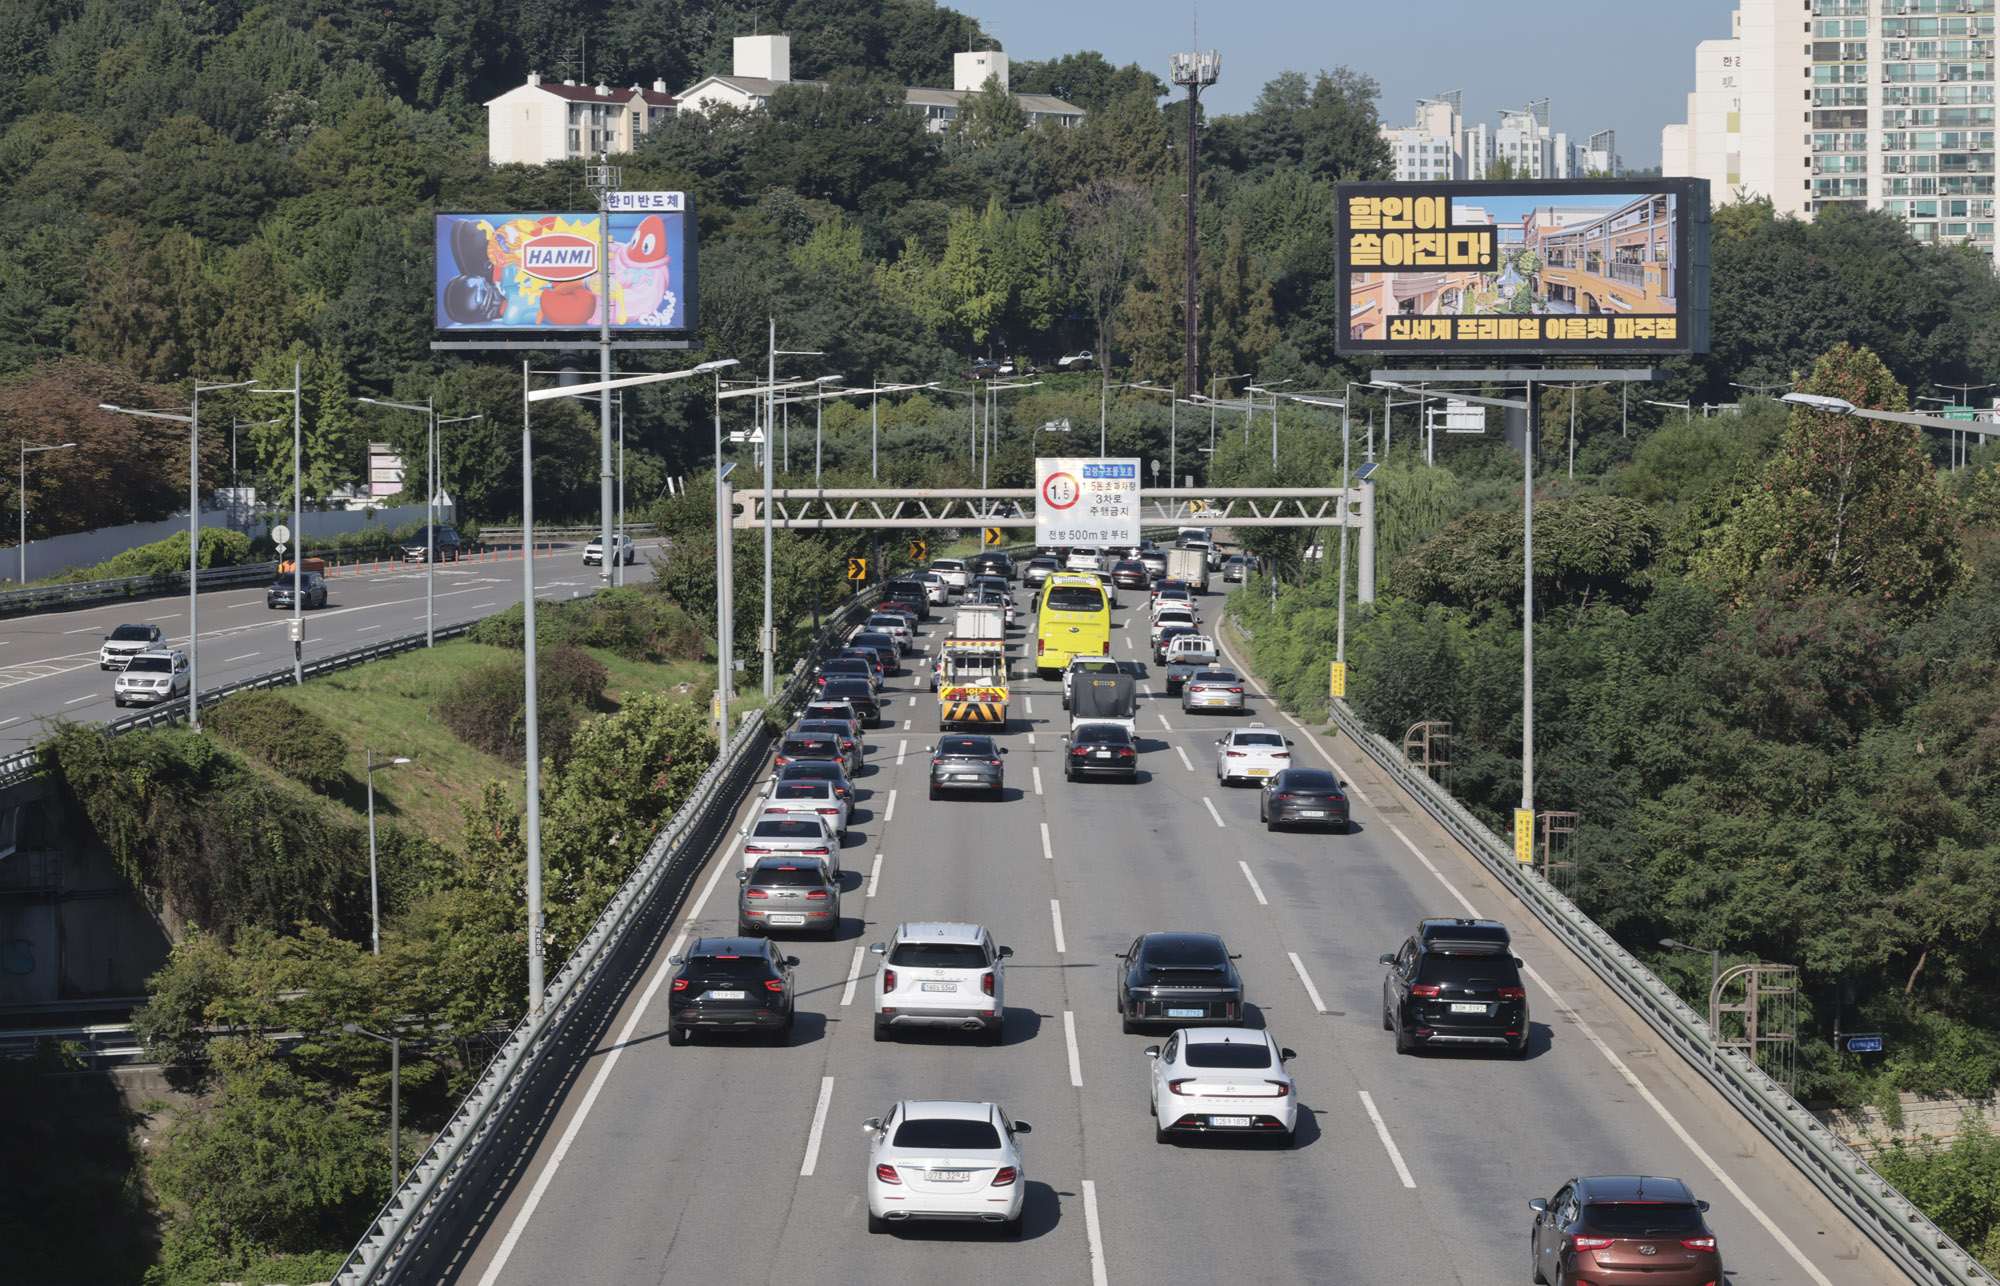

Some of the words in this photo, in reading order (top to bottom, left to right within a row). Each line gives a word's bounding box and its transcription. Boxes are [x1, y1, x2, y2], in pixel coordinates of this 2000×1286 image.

[608, 194, 679, 209] 한미반도체
[1349, 196, 1446, 230] 할인이
[1350, 232, 1491, 266] 쏟아진다!
[528, 249, 592, 265] HANMI
[1390, 318, 1452, 341] 신세계
[1457, 318, 1540, 340] 프리미엄
[1545, 318, 1608, 340] 아울렛
[1613, 317, 1677, 339] 파주점
[1095, 494, 1123, 504] 3차로
[1089, 506, 1129, 516] 주행금지
[1048, 530, 1066, 540] 전방
[1068, 530, 1098, 540] 500m
